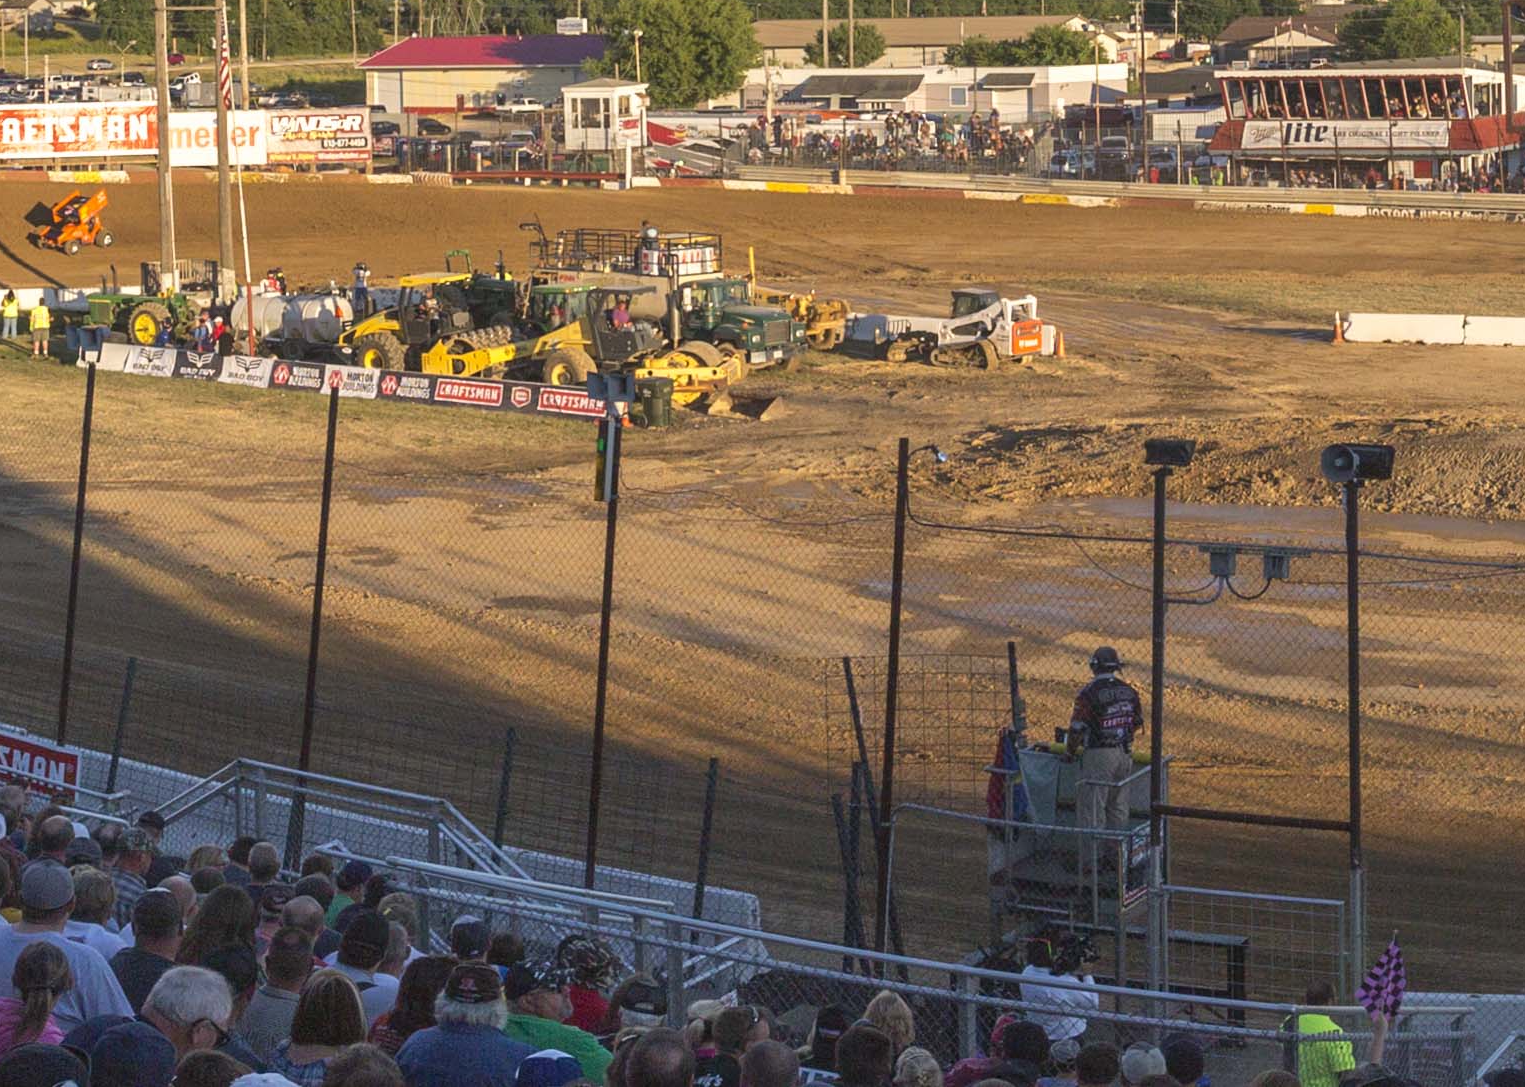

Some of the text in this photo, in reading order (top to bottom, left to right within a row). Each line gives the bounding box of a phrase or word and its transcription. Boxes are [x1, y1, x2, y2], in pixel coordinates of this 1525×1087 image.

[170, 125, 260, 148] meier
[246, 373, 264, 382] BOY
[345, 371, 374, 383] MORTON
[400, 376, 430, 389] MORTON
[396, 386, 431, 400] BUILDINGS
[439, 383, 500, 401] CRAFTSMAN
